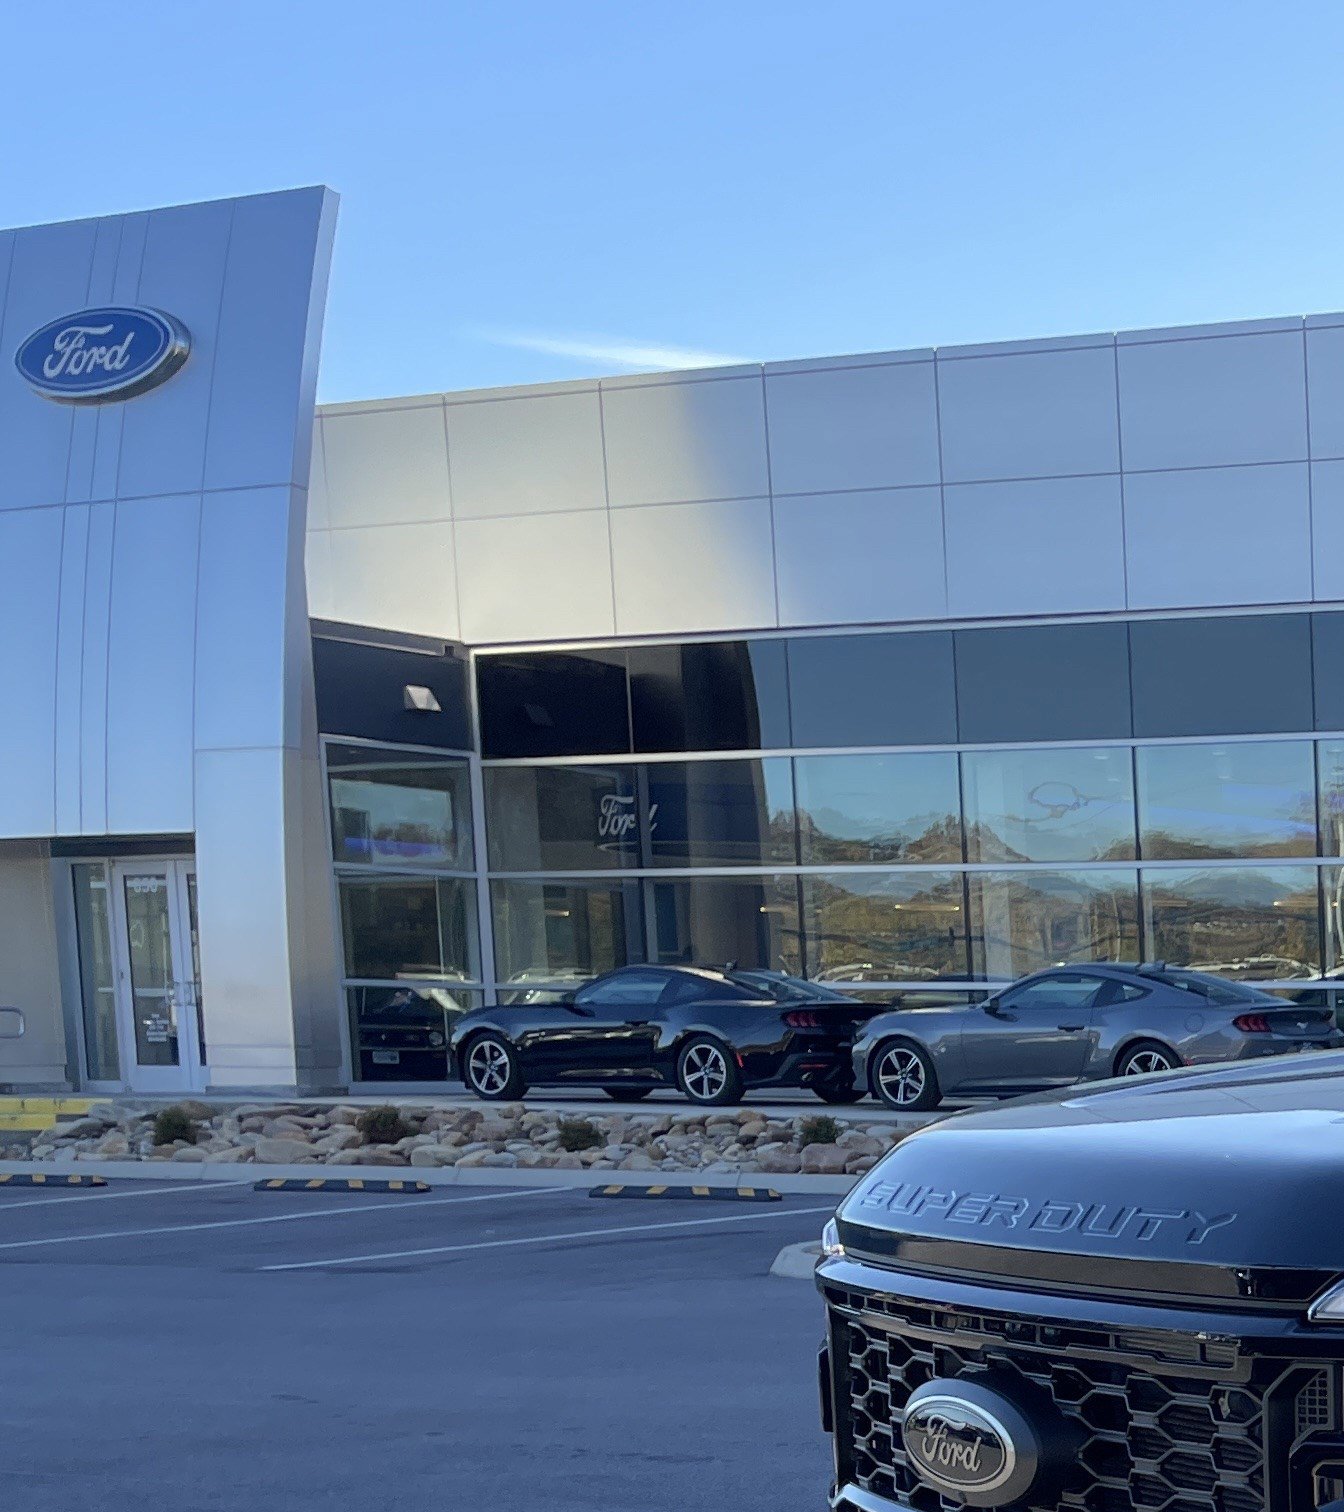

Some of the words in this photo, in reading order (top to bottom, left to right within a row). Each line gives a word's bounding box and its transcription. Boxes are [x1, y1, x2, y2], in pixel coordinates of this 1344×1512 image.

[43, 323, 135, 379] Ford
[861, 1179, 1029, 1229] SUPER
[1029, 1199, 1238, 1245] DUTY
[921, 1414, 982, 1472] Ford
